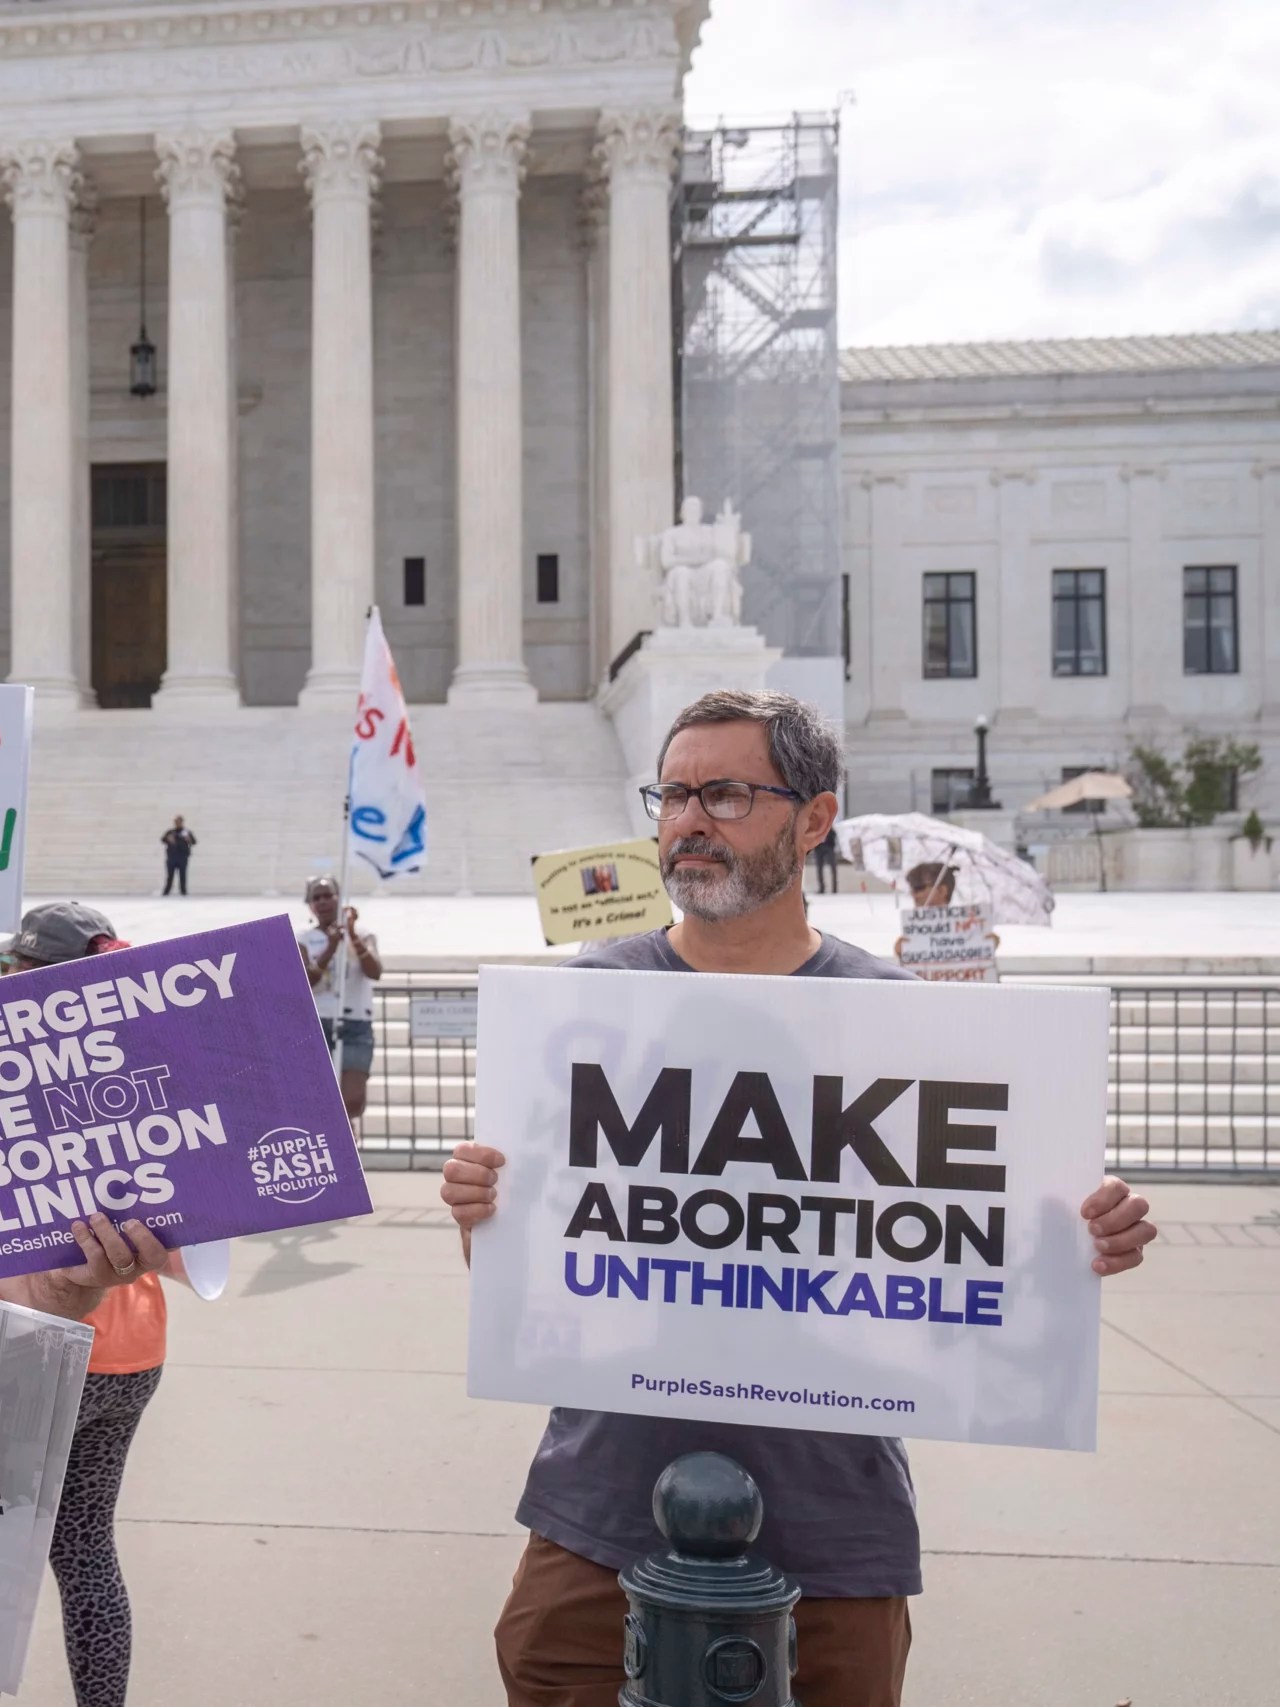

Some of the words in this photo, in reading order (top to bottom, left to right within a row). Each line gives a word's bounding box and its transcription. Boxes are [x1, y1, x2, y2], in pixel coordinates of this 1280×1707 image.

[572, 917, 591, 929] It's
[606, 908, 646, 924] Crime!
[903, 922, 950, 935] should
[929, 936, 966, 947] have
[43, 1064, 171, 1130] NOT
[568, 1061, 1010, 1193] MAKE
[247, 1133, 329, 1162] #PURPLE
[251, 1148, 335, 1184] SASH
[256, 1173, 338, 1197] REVOLUTION
[563, 1181, 1006, 1267] ABORTION
[563, 1251, 1004, 1327] UNTHINKABLE
[630, 1373, 917, 1414] PurpleSashRevolution.com
